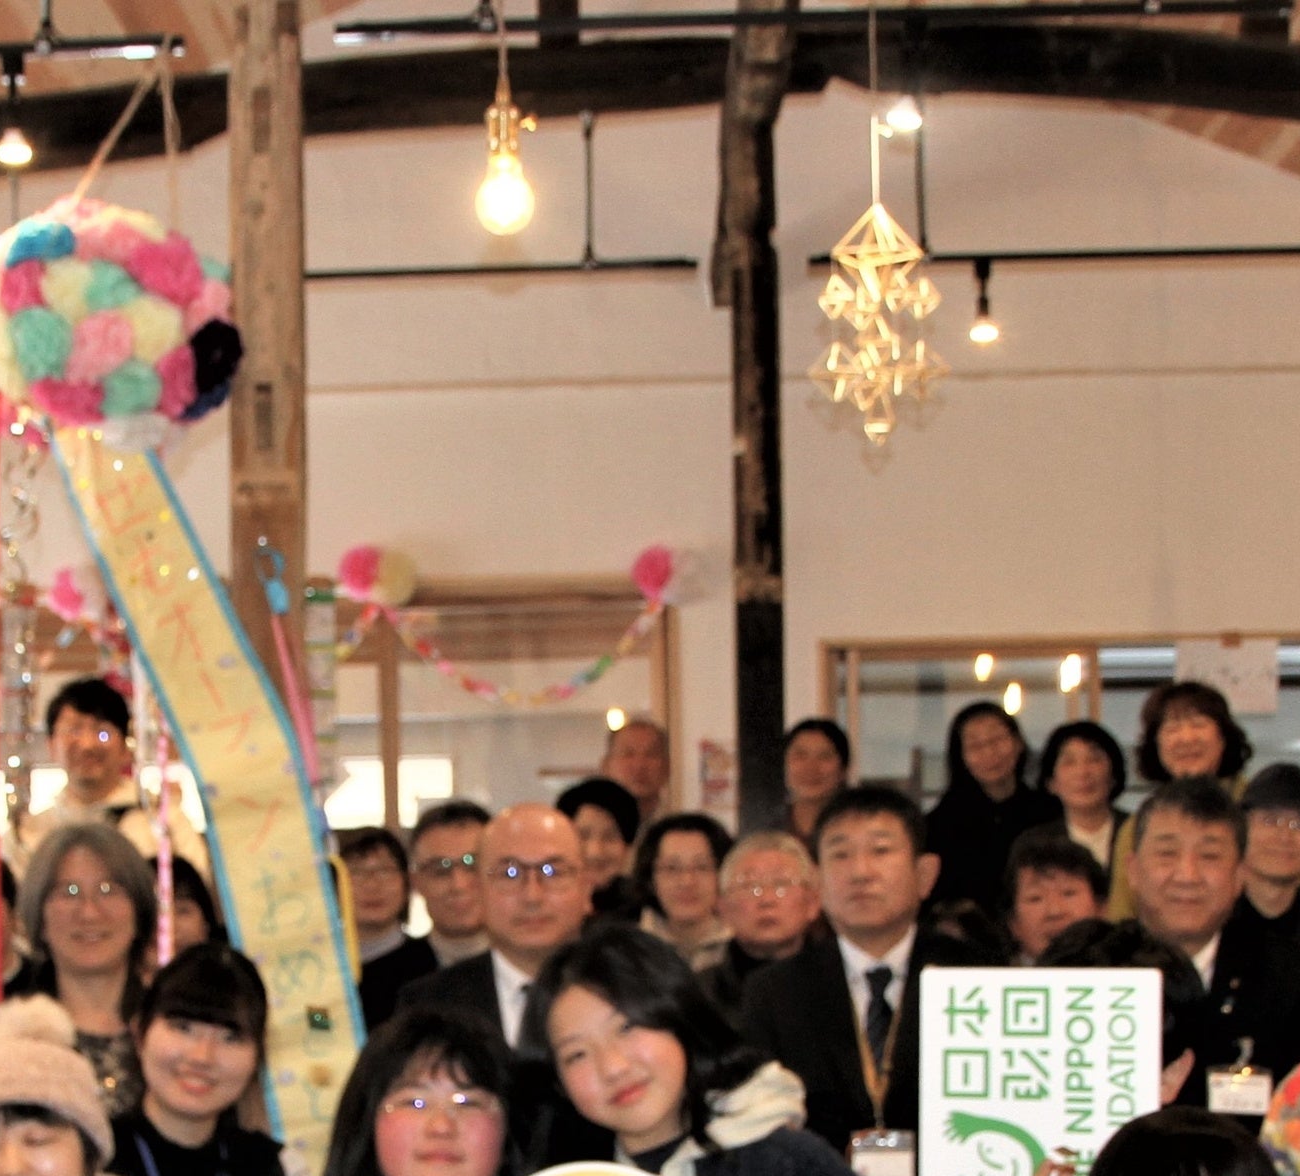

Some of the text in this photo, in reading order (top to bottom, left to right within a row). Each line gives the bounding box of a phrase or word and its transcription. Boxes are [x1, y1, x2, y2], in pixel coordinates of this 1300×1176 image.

[943, 986, 989, 1098] 日本
[1001, 987, 1049, 1099] 財団
[1066, 987, 1094, 1133] NIPPON
